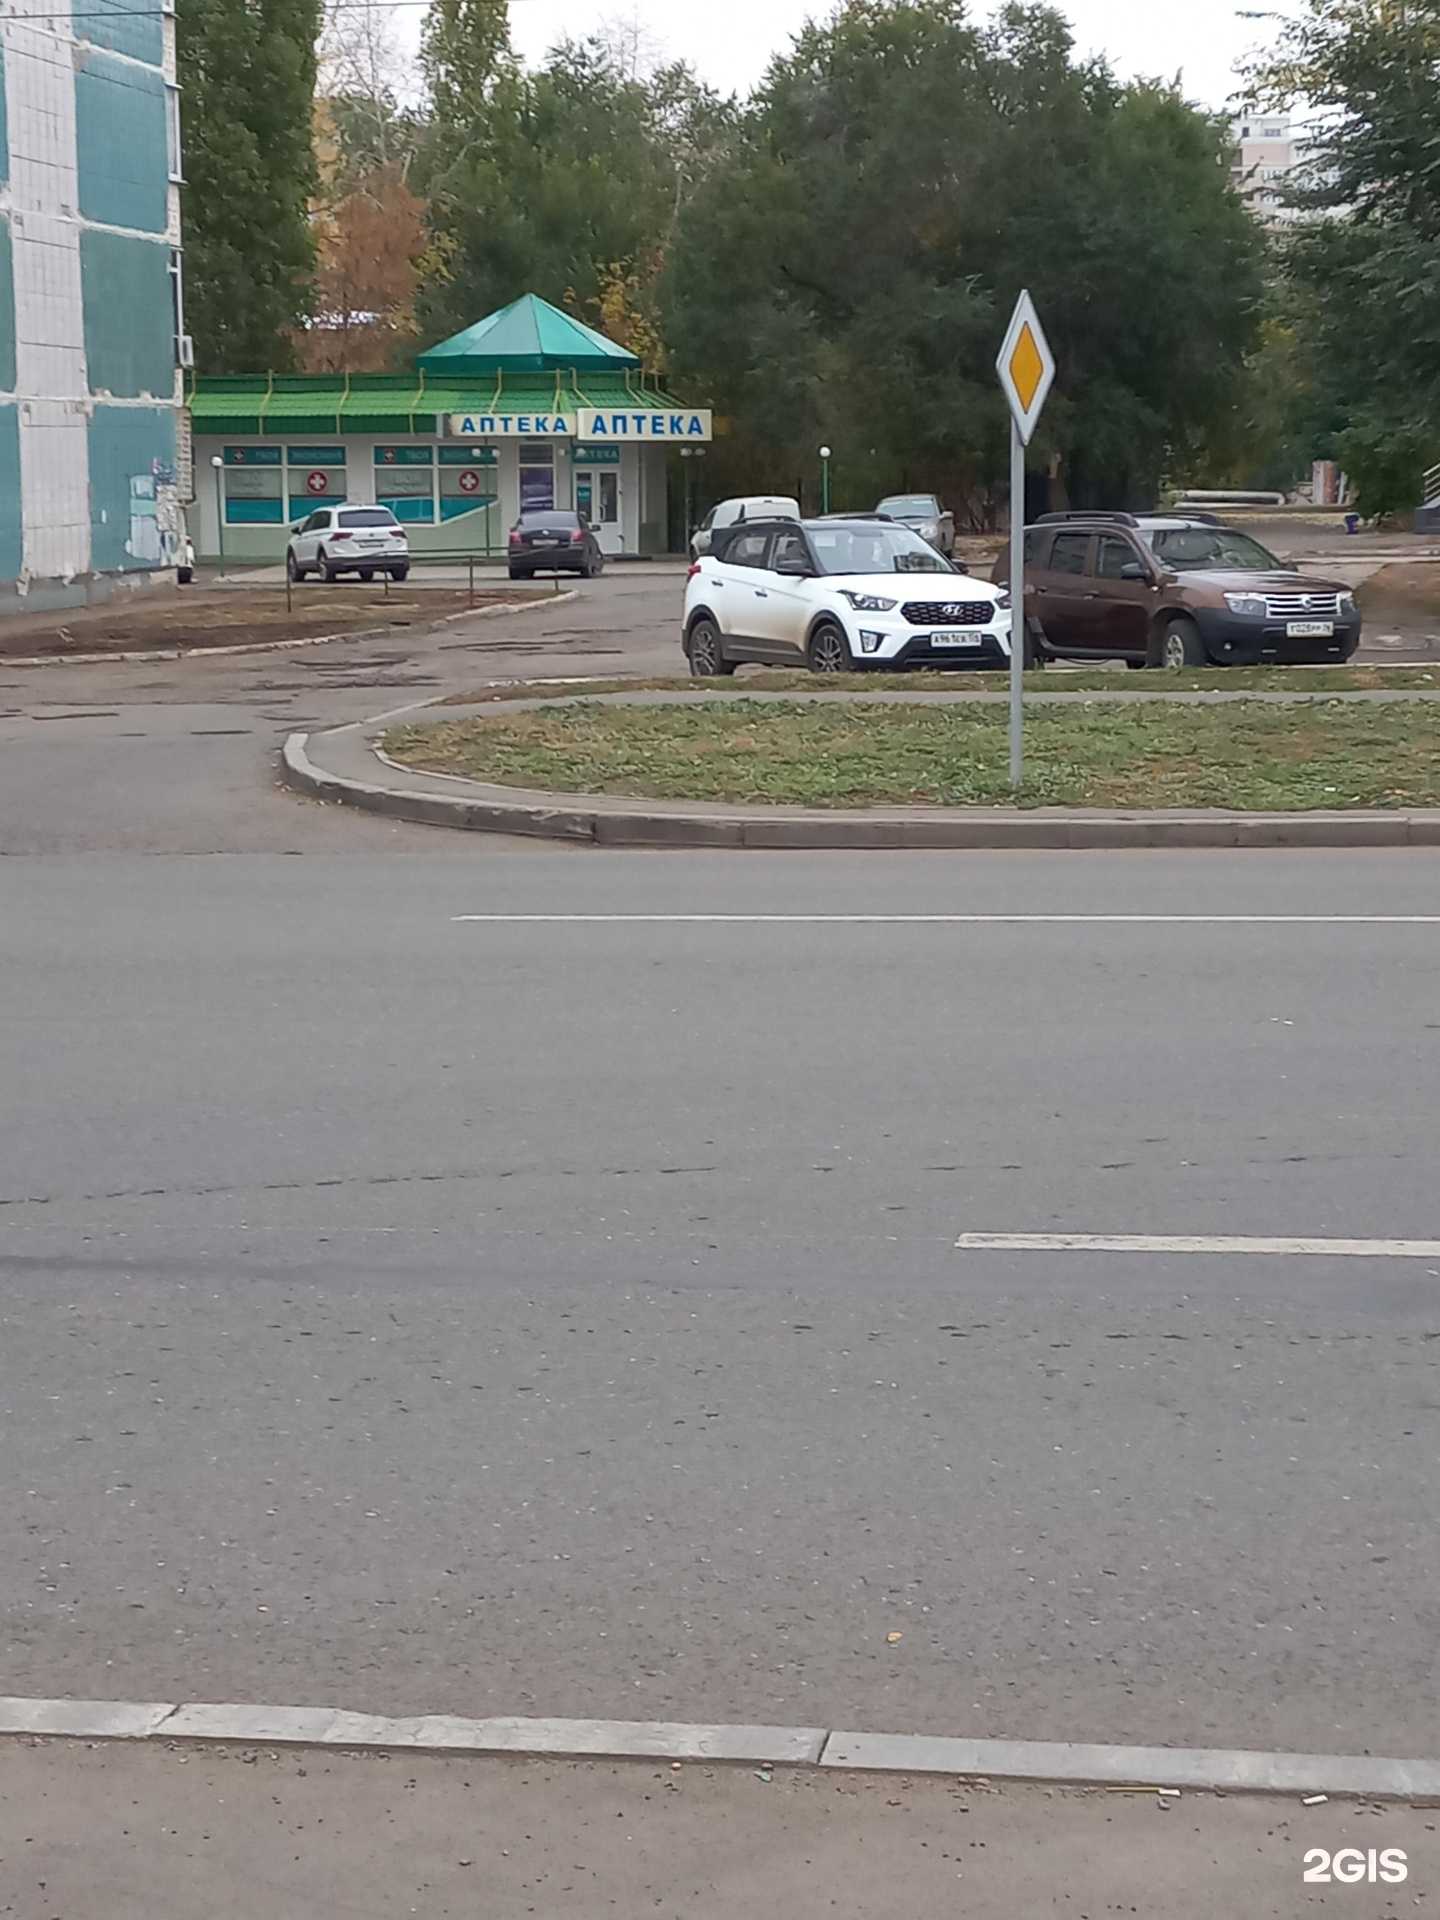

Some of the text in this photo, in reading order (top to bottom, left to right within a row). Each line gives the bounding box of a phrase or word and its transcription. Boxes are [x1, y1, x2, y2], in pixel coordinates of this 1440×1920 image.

[461, 417, 568, 433] АПТЕКА
[591, 415, 704, 435] АПТЕКА
[575, 447, 618, 459] ТЕКА
